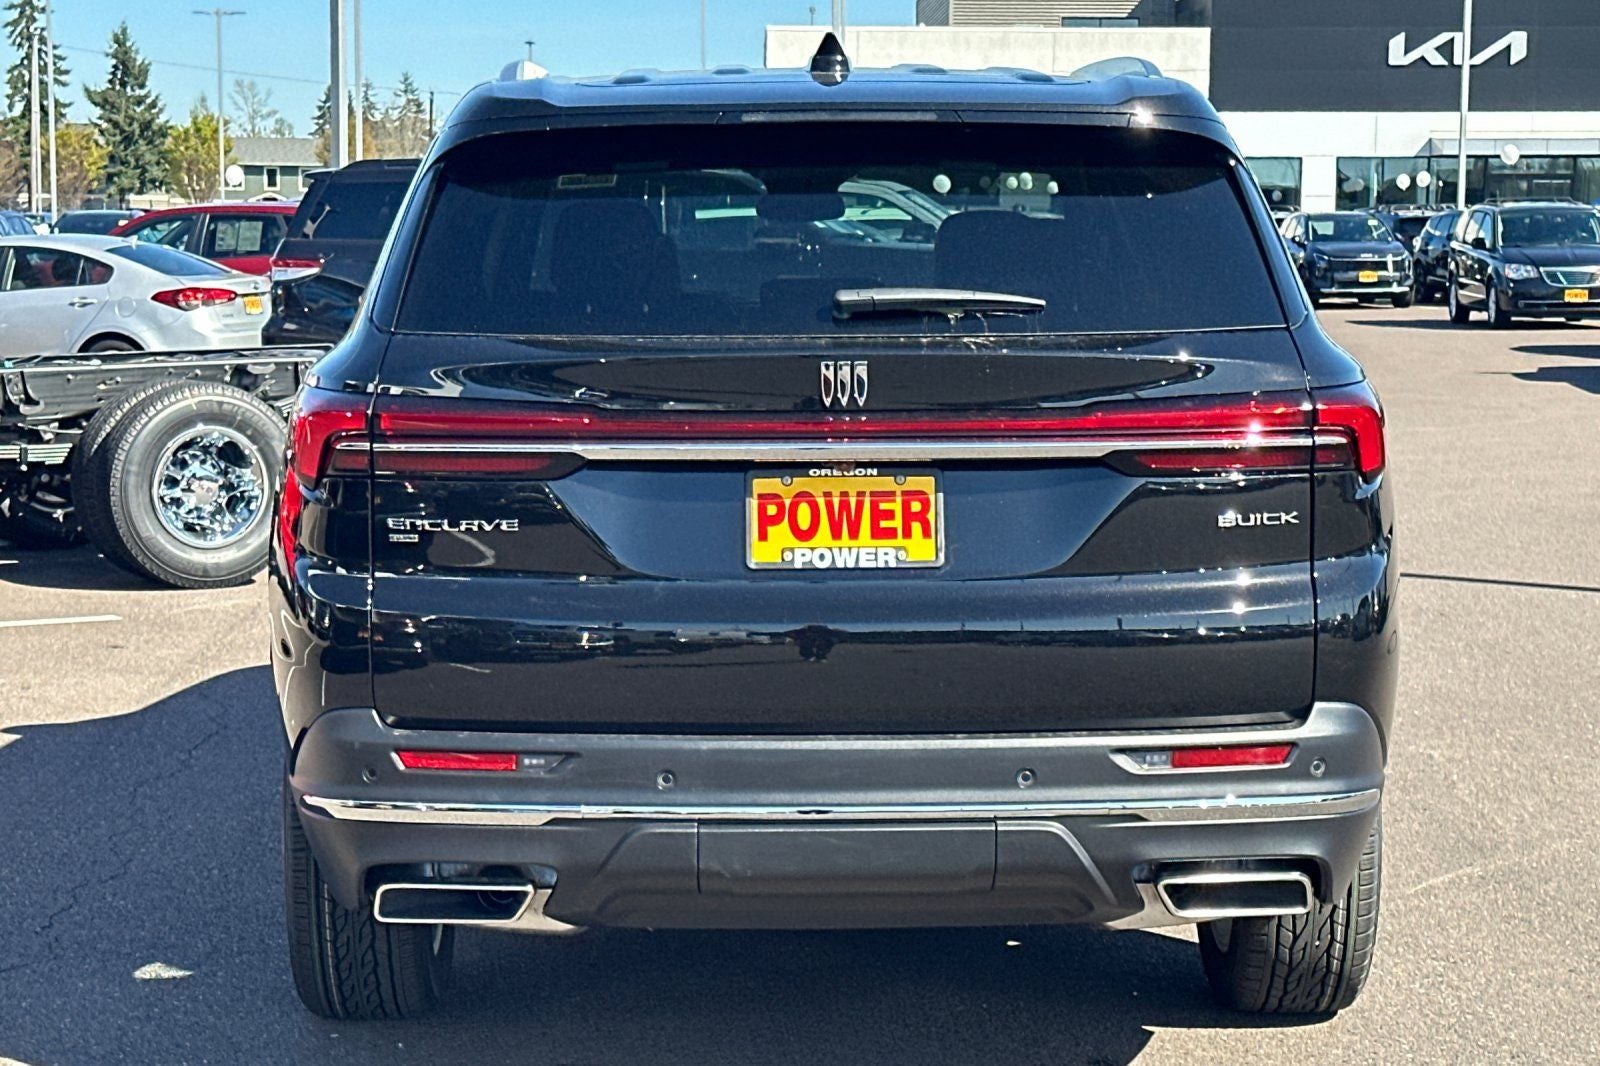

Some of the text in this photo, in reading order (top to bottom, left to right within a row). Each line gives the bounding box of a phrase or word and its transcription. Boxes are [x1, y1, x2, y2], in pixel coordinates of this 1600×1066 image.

[1388, 31, 1527, 66] KIA
[387, 517, 519, 532] ENCLAVE
[757, 490, 932, 542] POWER
[1217, 510, 1300, 528] BUICK
[793, 547, 897, 569] POWER
